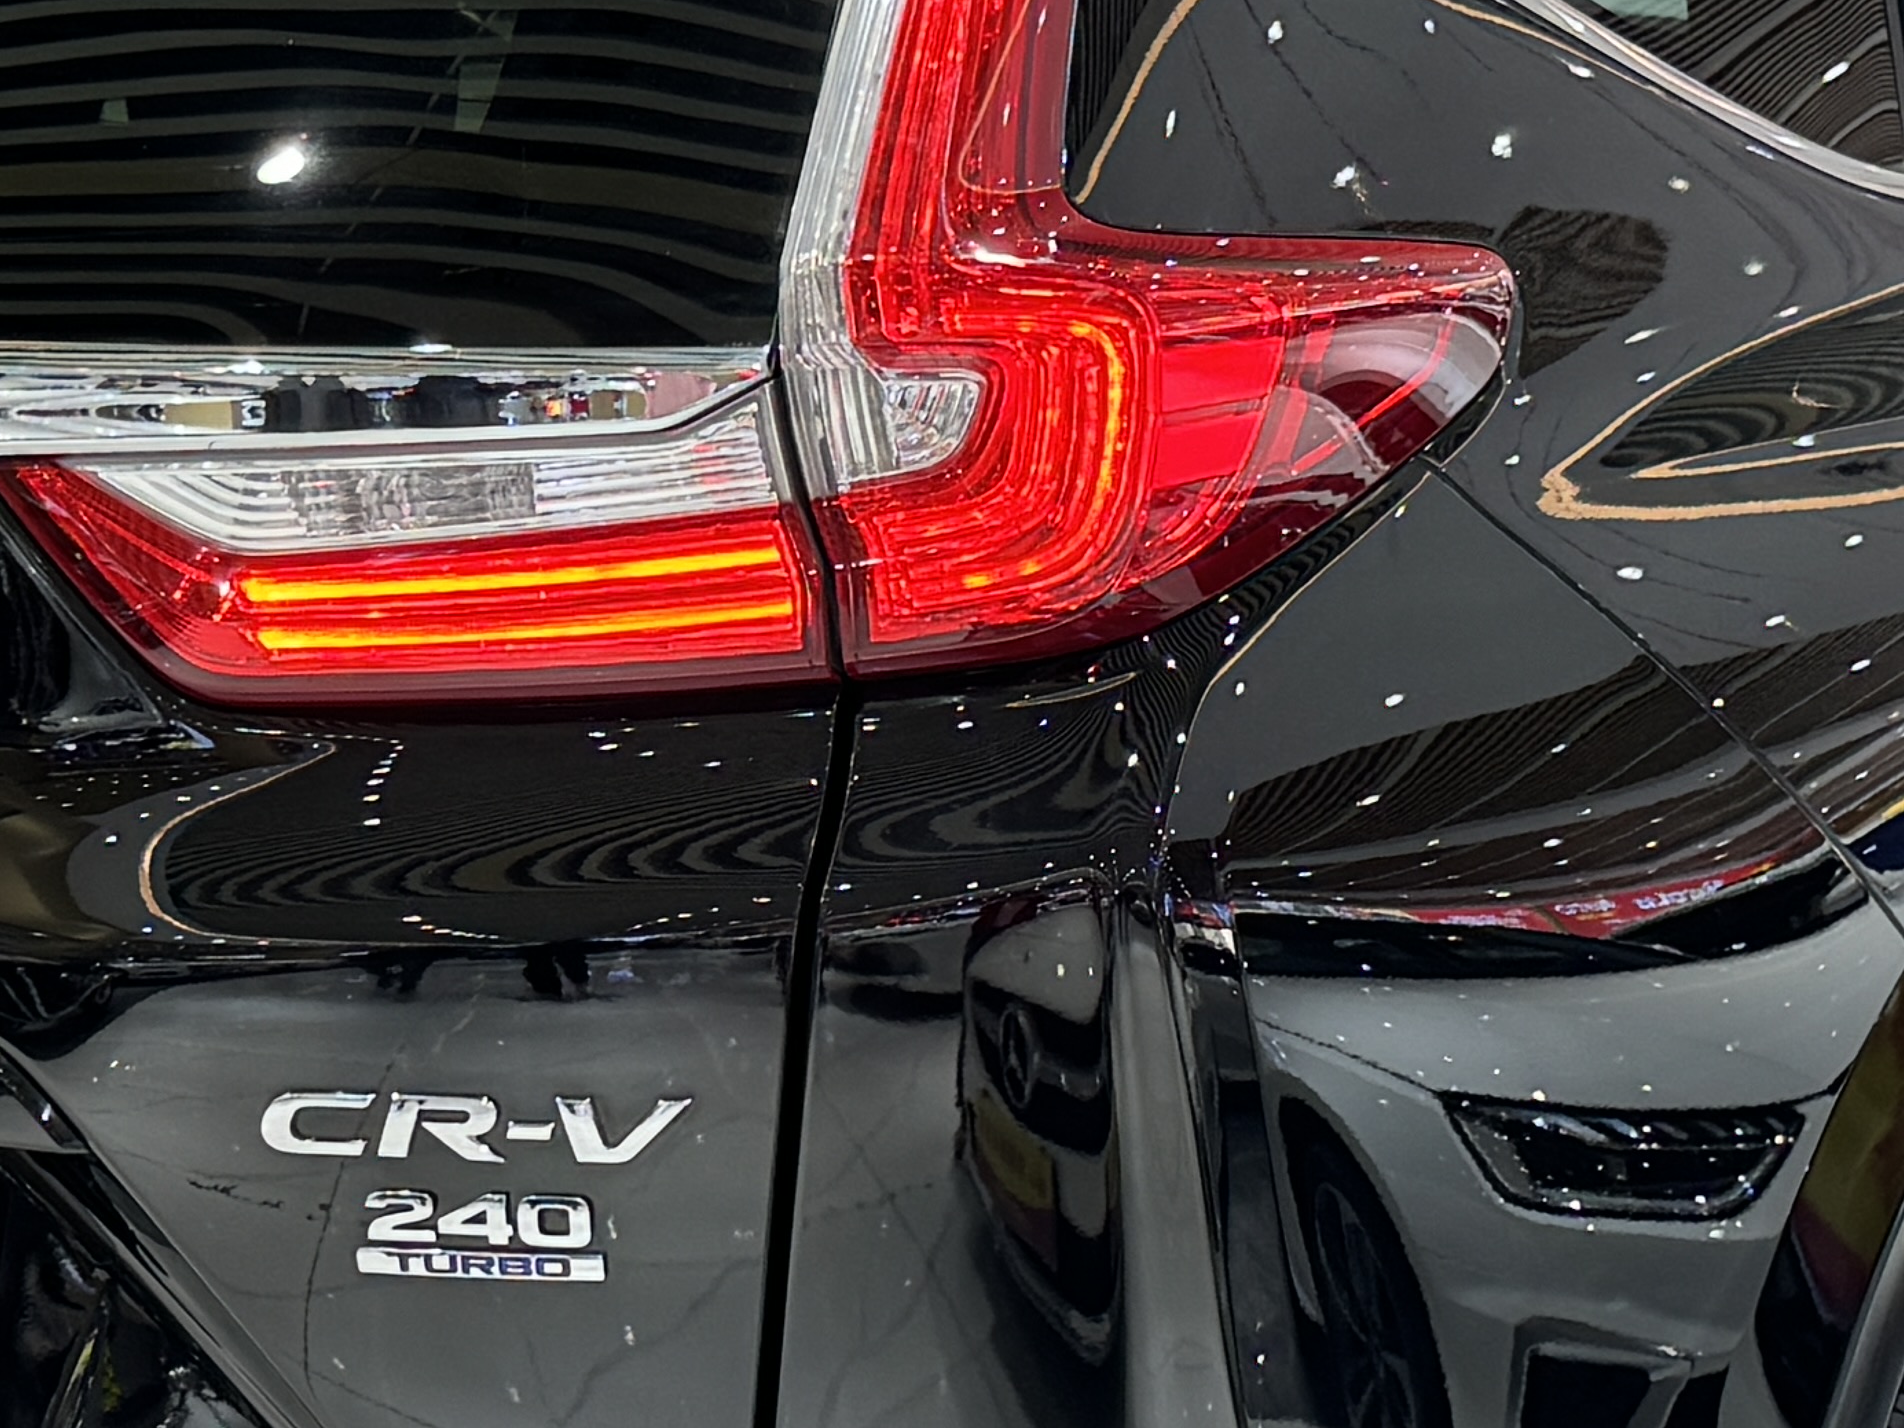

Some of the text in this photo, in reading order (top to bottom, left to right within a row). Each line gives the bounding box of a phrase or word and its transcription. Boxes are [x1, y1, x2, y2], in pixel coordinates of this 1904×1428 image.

[260, 1090, 694, 1164] CR-V
[364, 1189, 594, 1249] 240
[395, 1252, 572, 1278] TURBO
